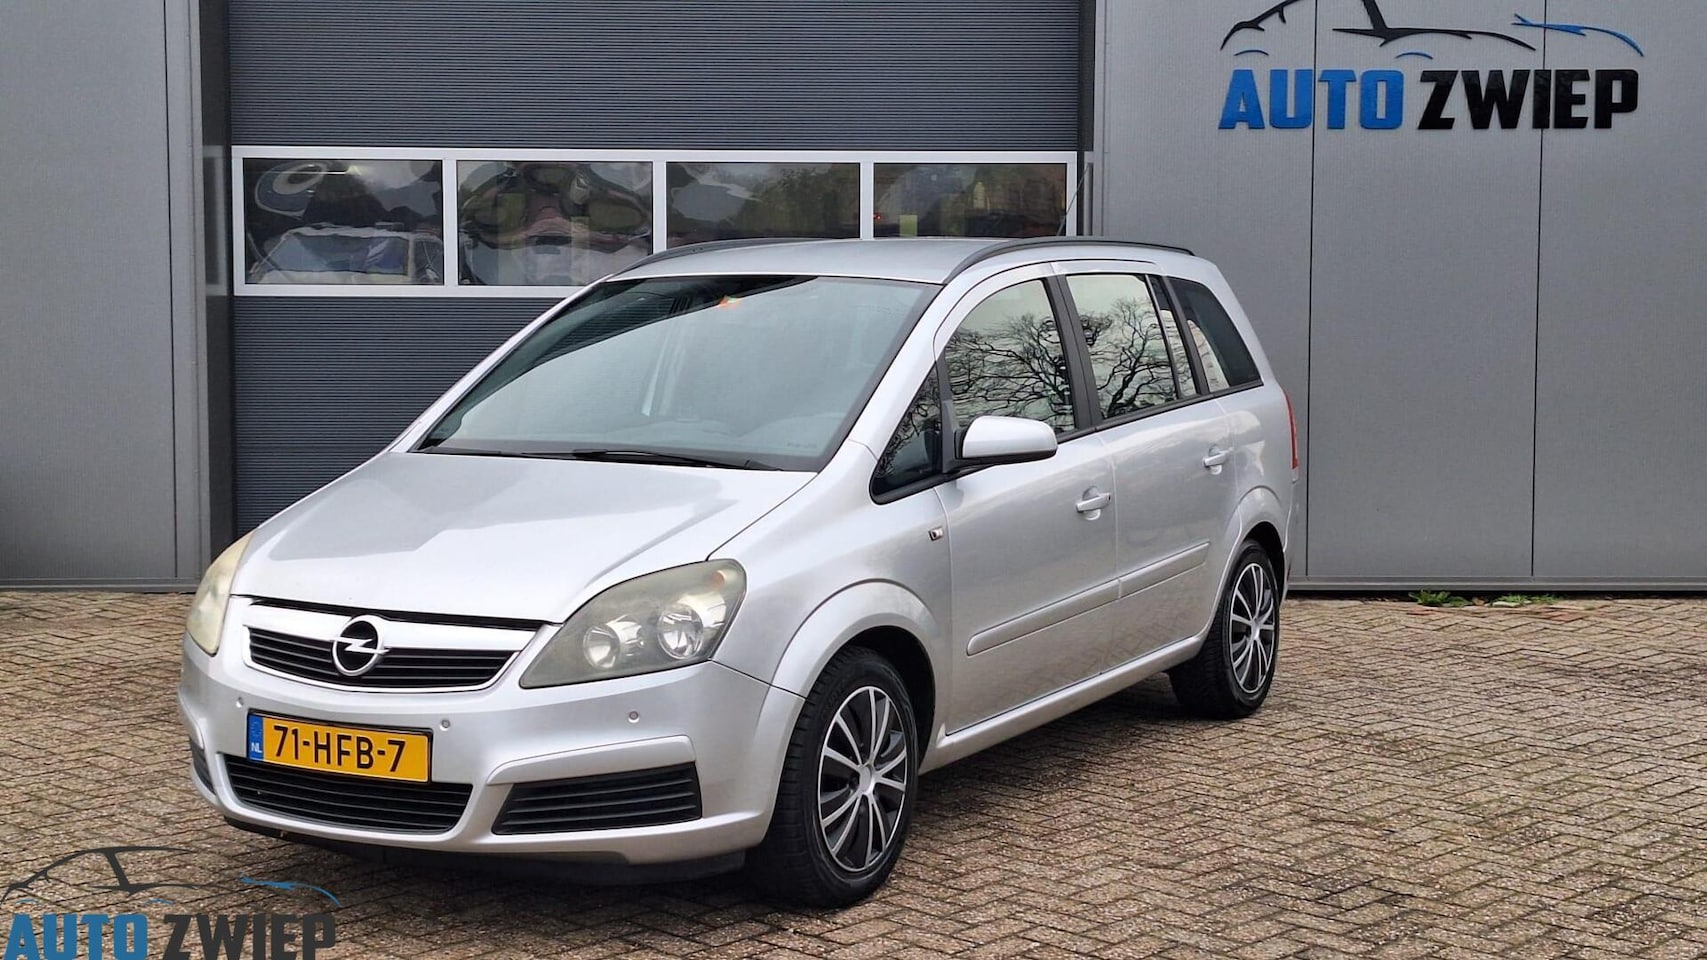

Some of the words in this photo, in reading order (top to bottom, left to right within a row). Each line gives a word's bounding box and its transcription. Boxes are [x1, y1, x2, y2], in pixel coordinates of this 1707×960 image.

[1218, 69, 1404, 129] AUTO
[1418, 69, 1639, 129] ZWIEP
[251, 742, 262, 753] NL
[273, 725, 405, 772] 71-HFB-7
